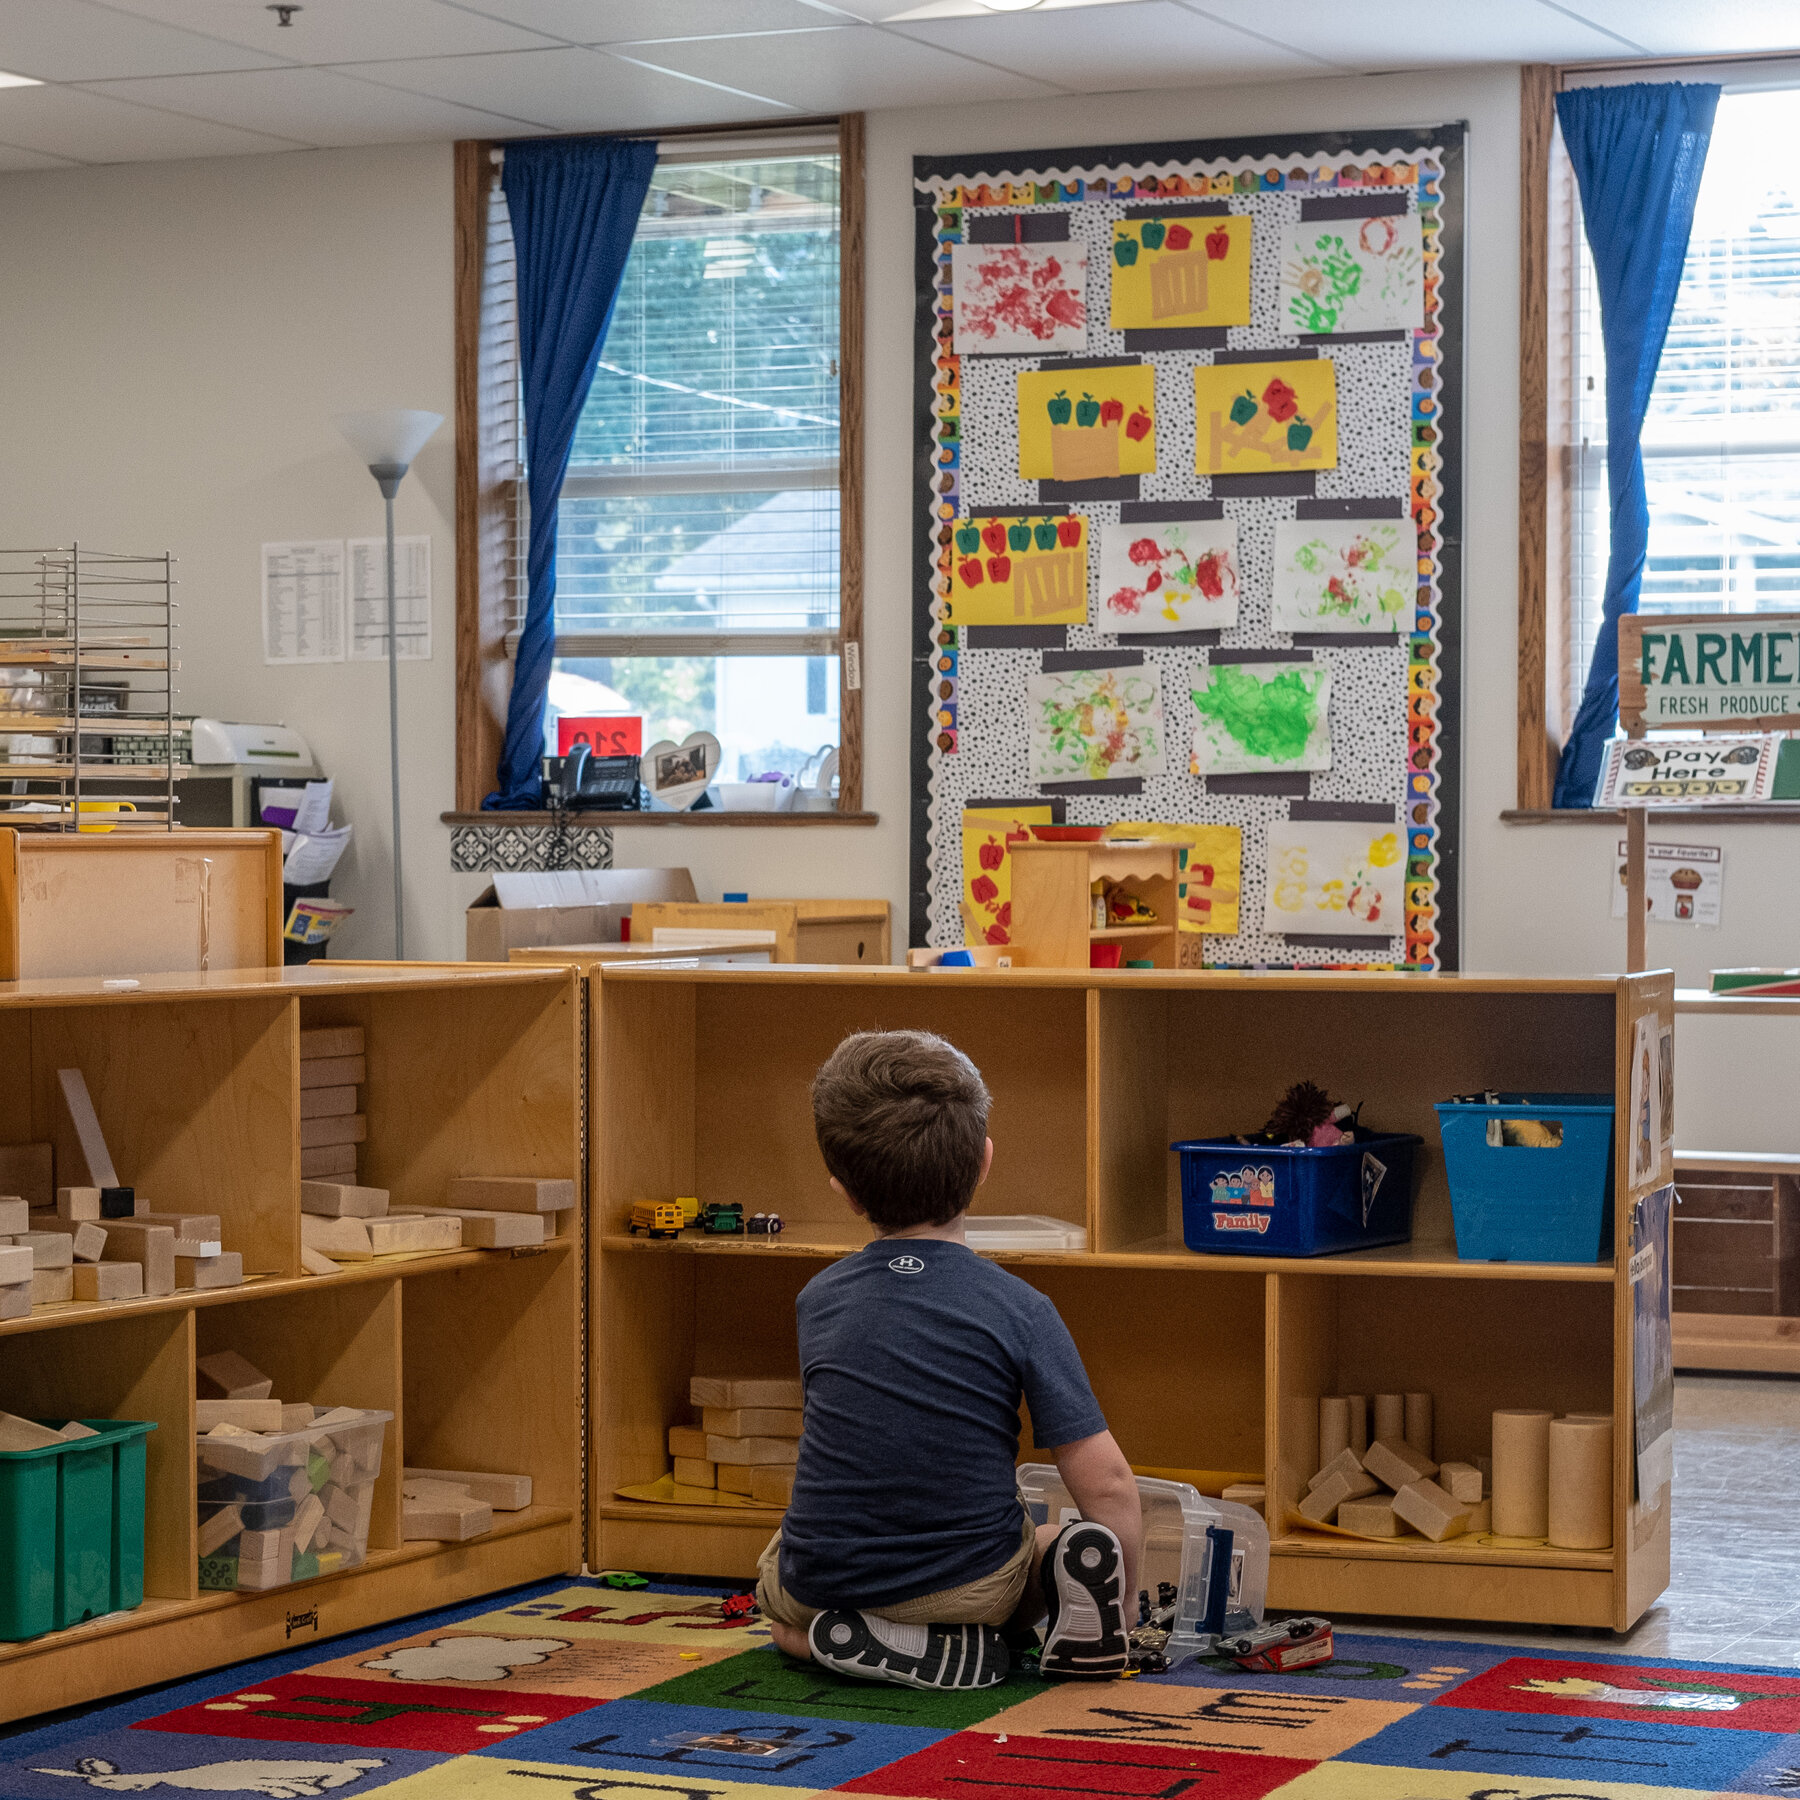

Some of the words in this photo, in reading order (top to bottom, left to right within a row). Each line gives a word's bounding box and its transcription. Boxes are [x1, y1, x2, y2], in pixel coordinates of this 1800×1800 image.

[846, 644, 856, 688] Window
[1640, 632, 1800, 686] FARME
[1659, 696, 1709, 715] FRESH
[1720, 695, 1789, 714] PRODUCE
[1663, 749, 1721, 764] Pay
[1651, 766, 1726, 780] Here
[1214, 1213, 1271, 1233] Family
